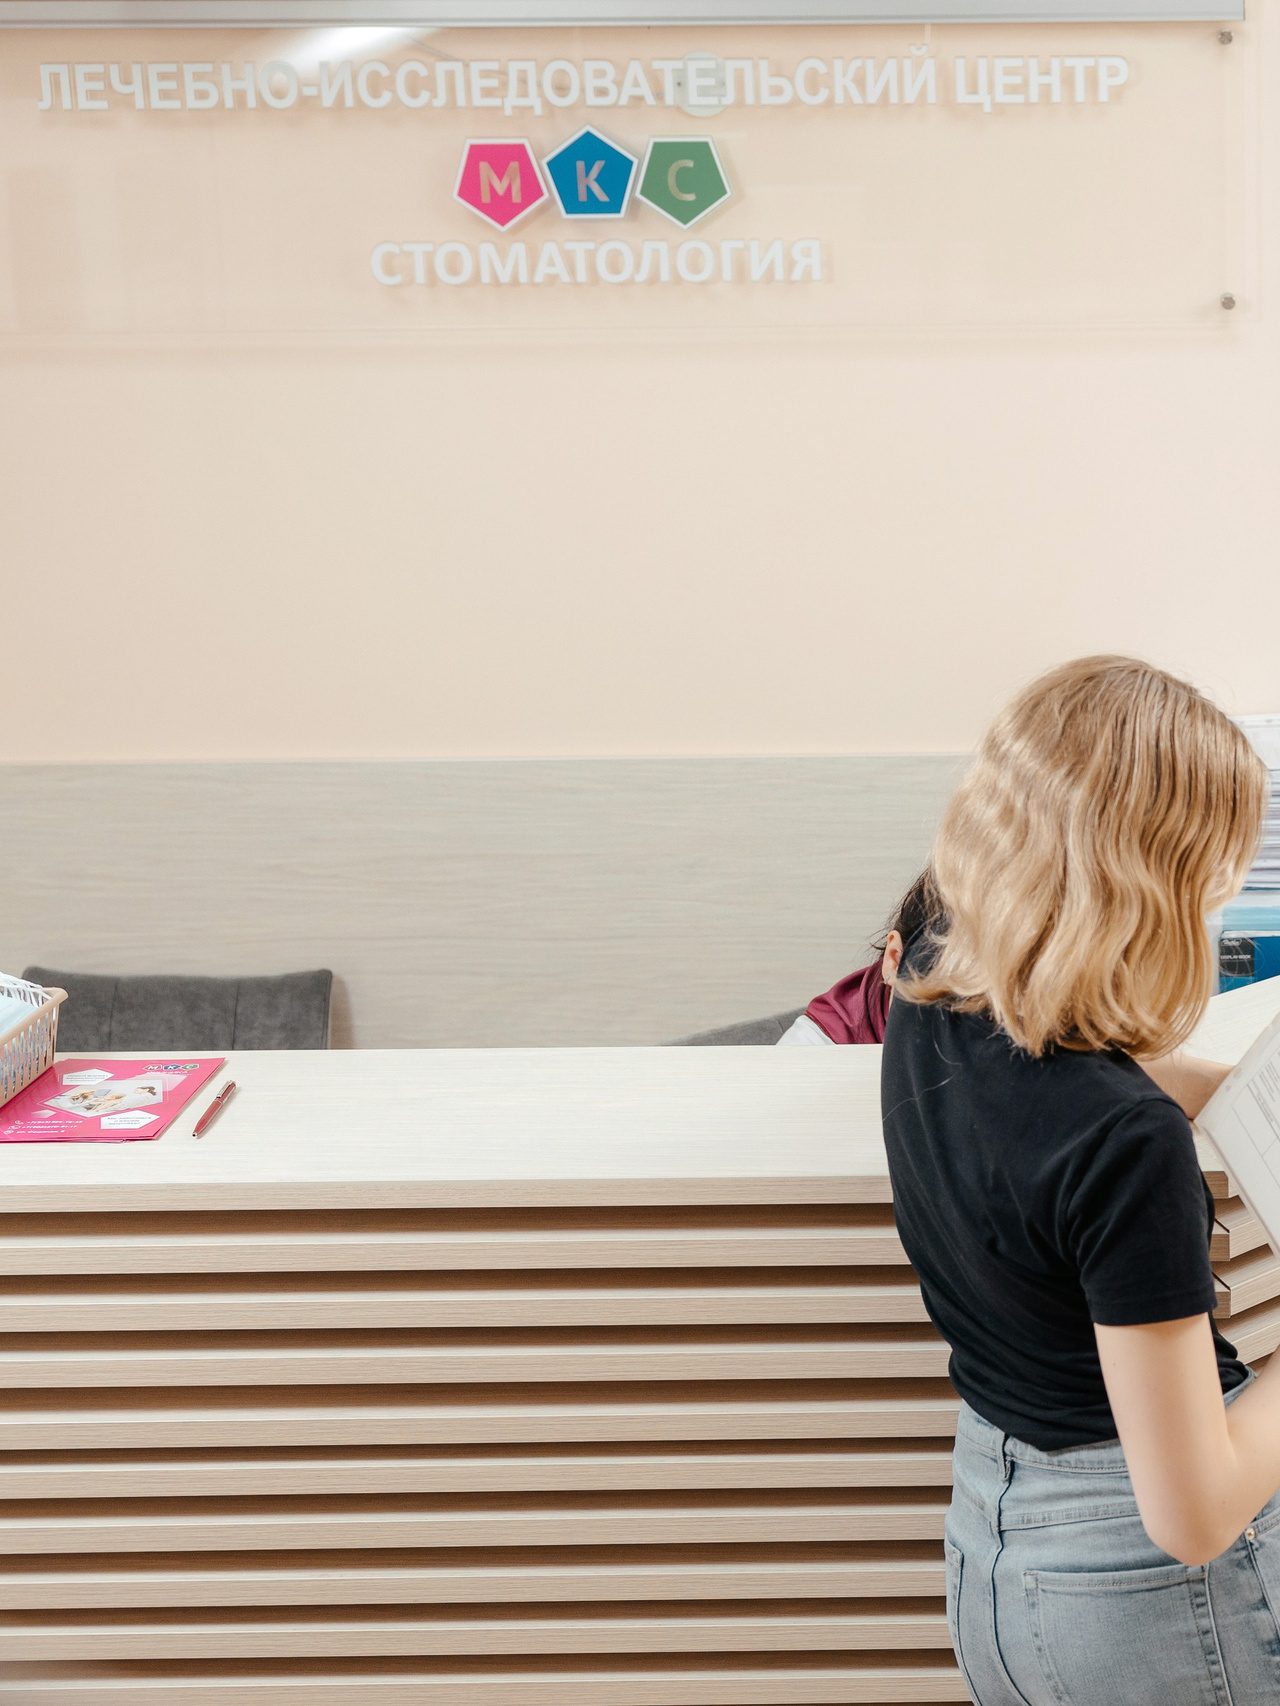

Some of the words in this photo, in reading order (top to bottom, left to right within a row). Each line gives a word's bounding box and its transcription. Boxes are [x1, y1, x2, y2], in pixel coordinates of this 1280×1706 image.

[38, 45, 937, 116] ЛЕЧЕБНО-ИССЛЕДОВАТЕЛЬСКИЙ
[955, 56, 1129, 113] ЦЕНТР
[370, 238, 823, 287] СТОМАТОЛОГИЯ
